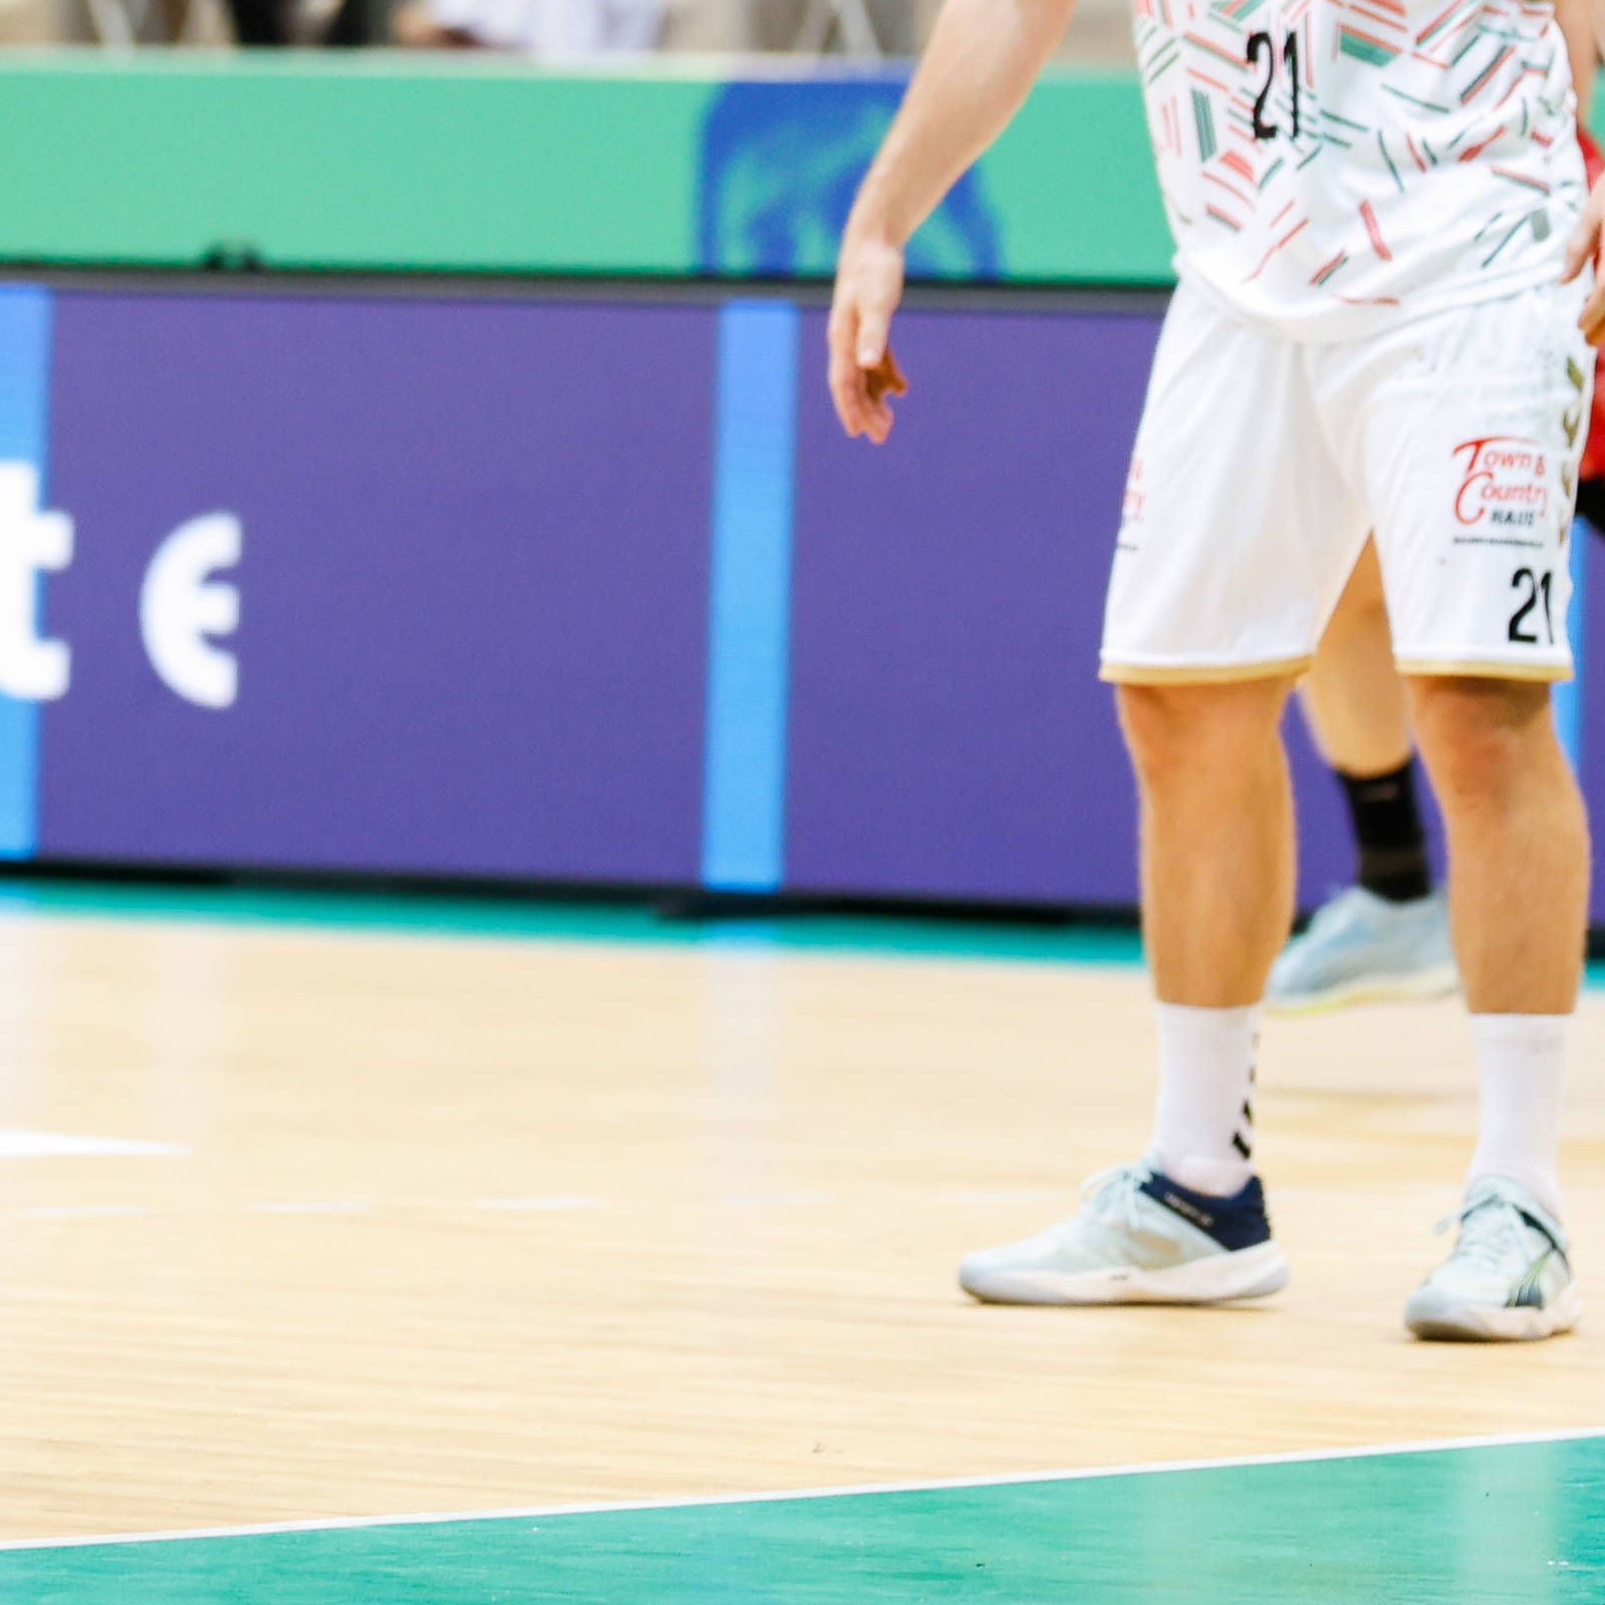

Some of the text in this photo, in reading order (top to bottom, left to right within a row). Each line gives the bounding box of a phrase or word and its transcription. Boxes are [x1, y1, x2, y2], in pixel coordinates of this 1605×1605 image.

[1246, 31, 1300, 139] 21
[1452, 436, 1539, 473] Town
[1455, 471, 1547, 525] Country
[1508, 567, 1554, 645] 21
